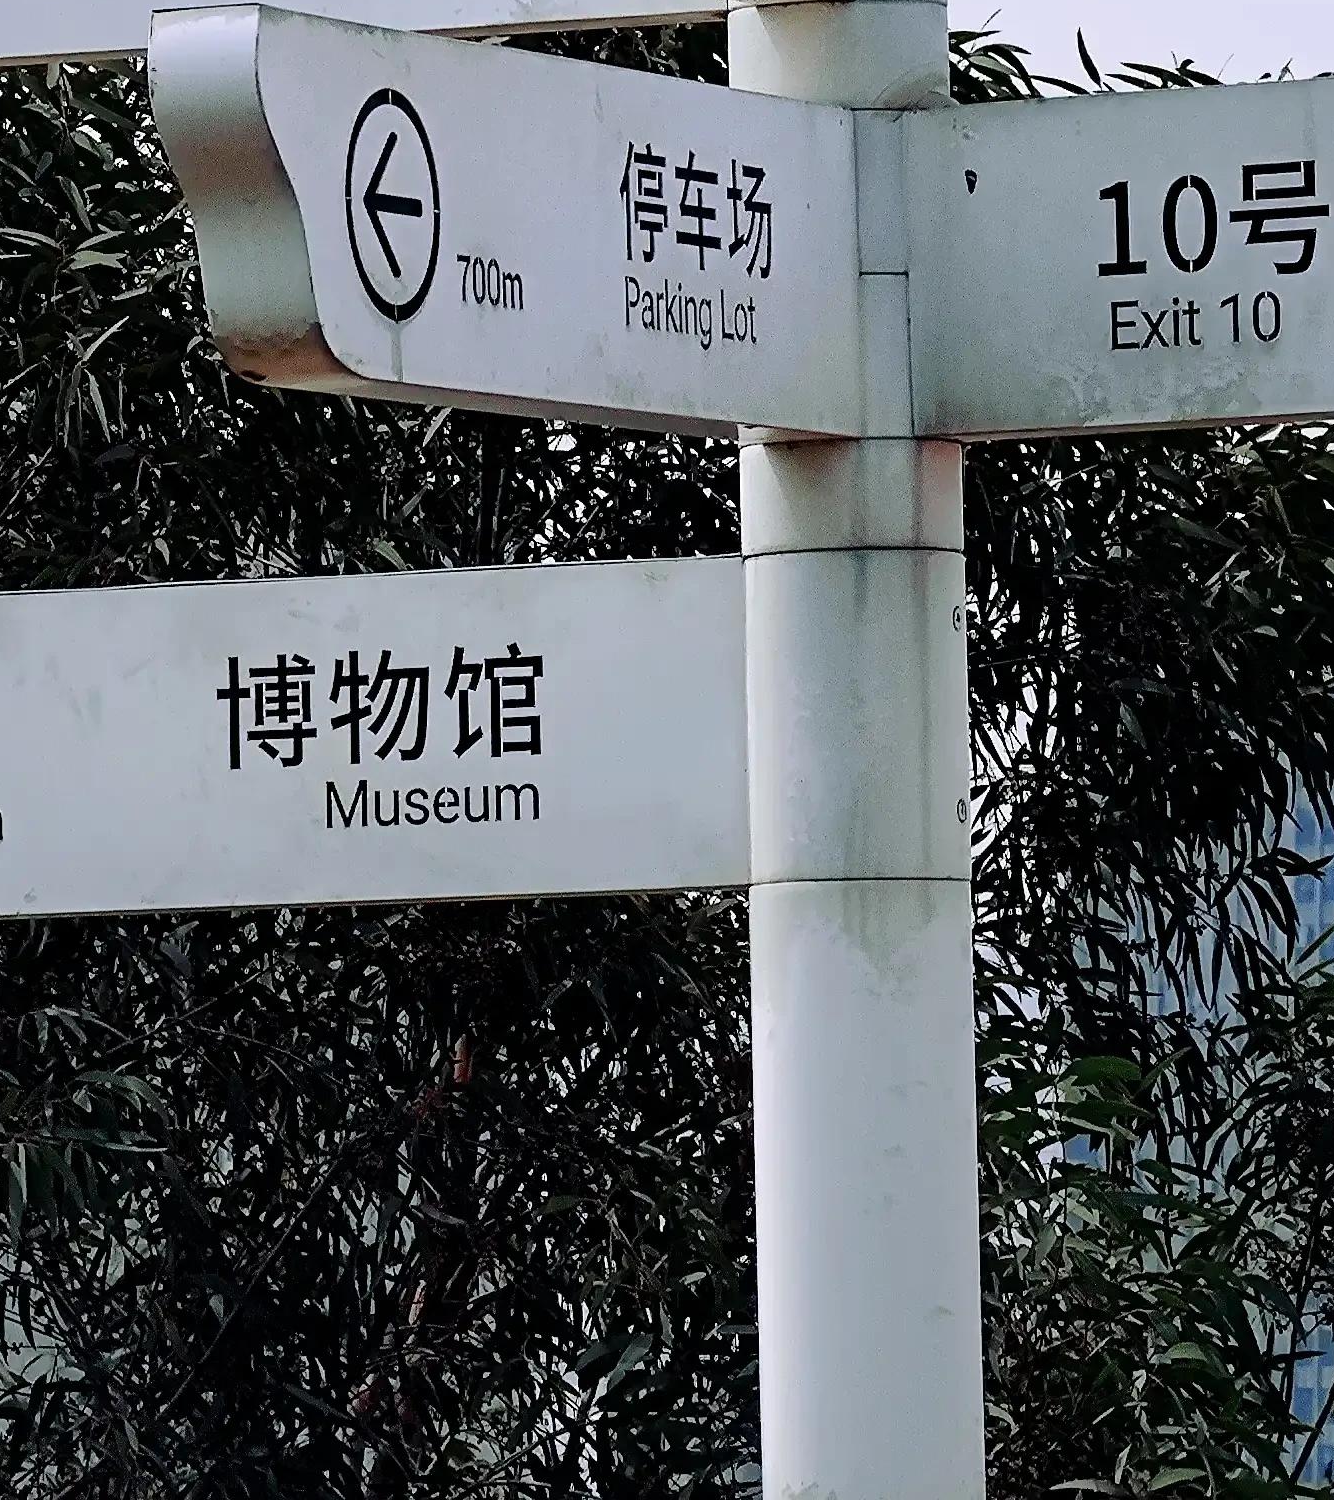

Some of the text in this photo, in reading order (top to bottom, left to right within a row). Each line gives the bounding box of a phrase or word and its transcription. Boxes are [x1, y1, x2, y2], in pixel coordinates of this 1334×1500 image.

[620, 141, 773, 279] 停车场
[457, 254, 524, 311] 700m
[624, 276, 758, 350] Parking Lot
[1109, 290, 1281, 352] Exit 10
[216, 642, 544, 771] 博物馆
[325, 780, 540, 829] Museum
